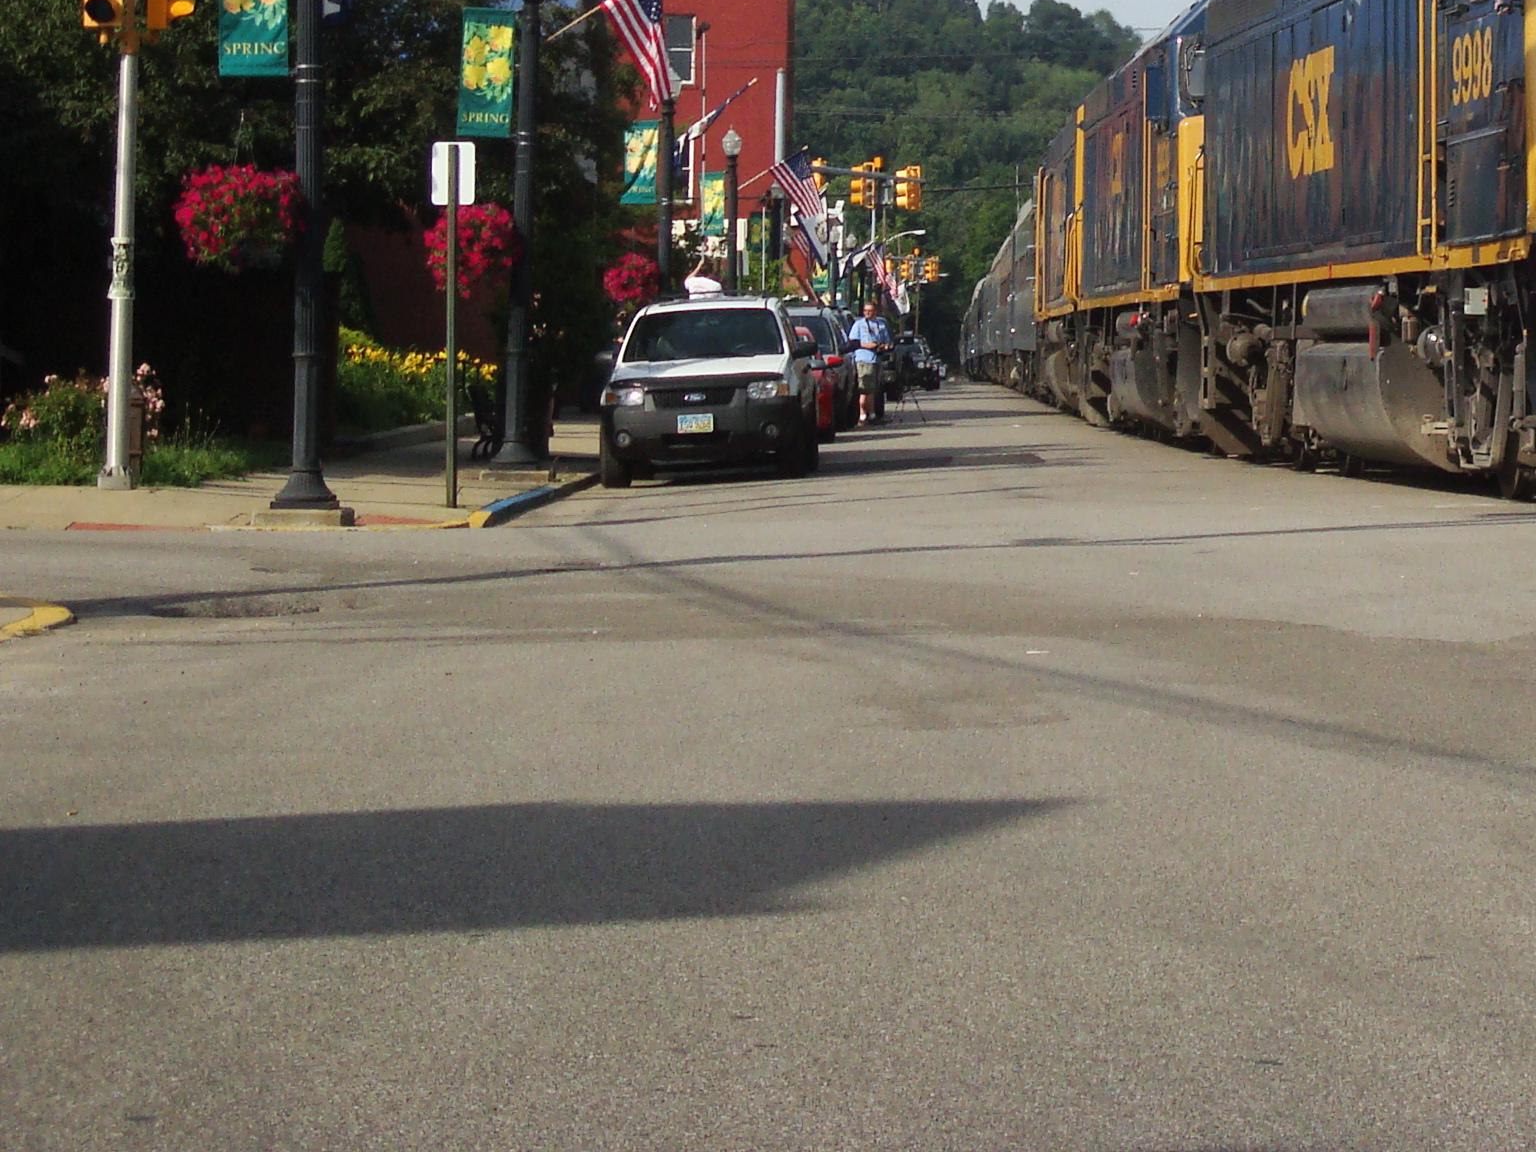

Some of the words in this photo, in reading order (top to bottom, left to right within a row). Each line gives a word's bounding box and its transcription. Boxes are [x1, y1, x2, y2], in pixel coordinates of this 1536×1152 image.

[223, 41, 286, 55] SPRING
[1452, 26, 1493, 106] 9998
[461, 111, 509, 124] SPRING
[1286, 45, 1335, 180] CSX
